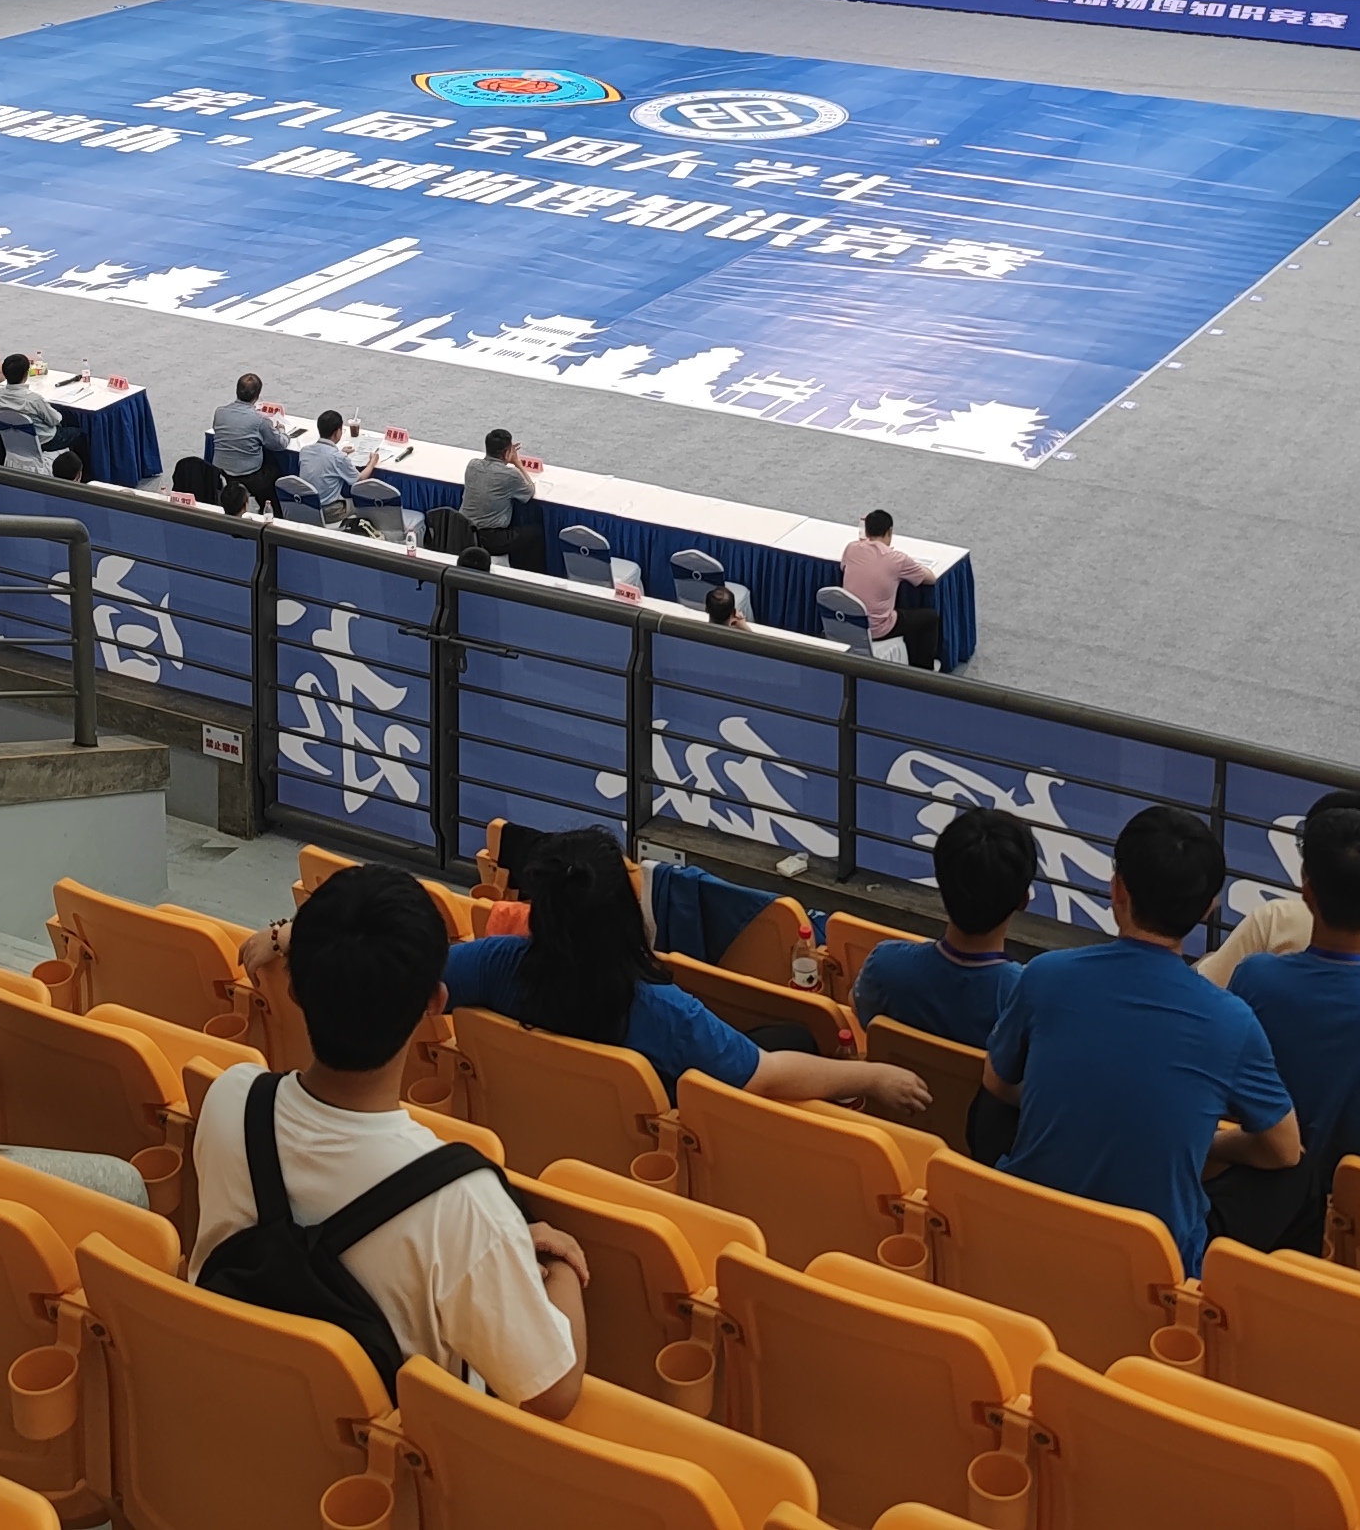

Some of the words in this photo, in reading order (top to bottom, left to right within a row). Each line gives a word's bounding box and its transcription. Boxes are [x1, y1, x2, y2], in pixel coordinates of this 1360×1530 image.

[131, 85, 912, 208] 第九届全国大学生
